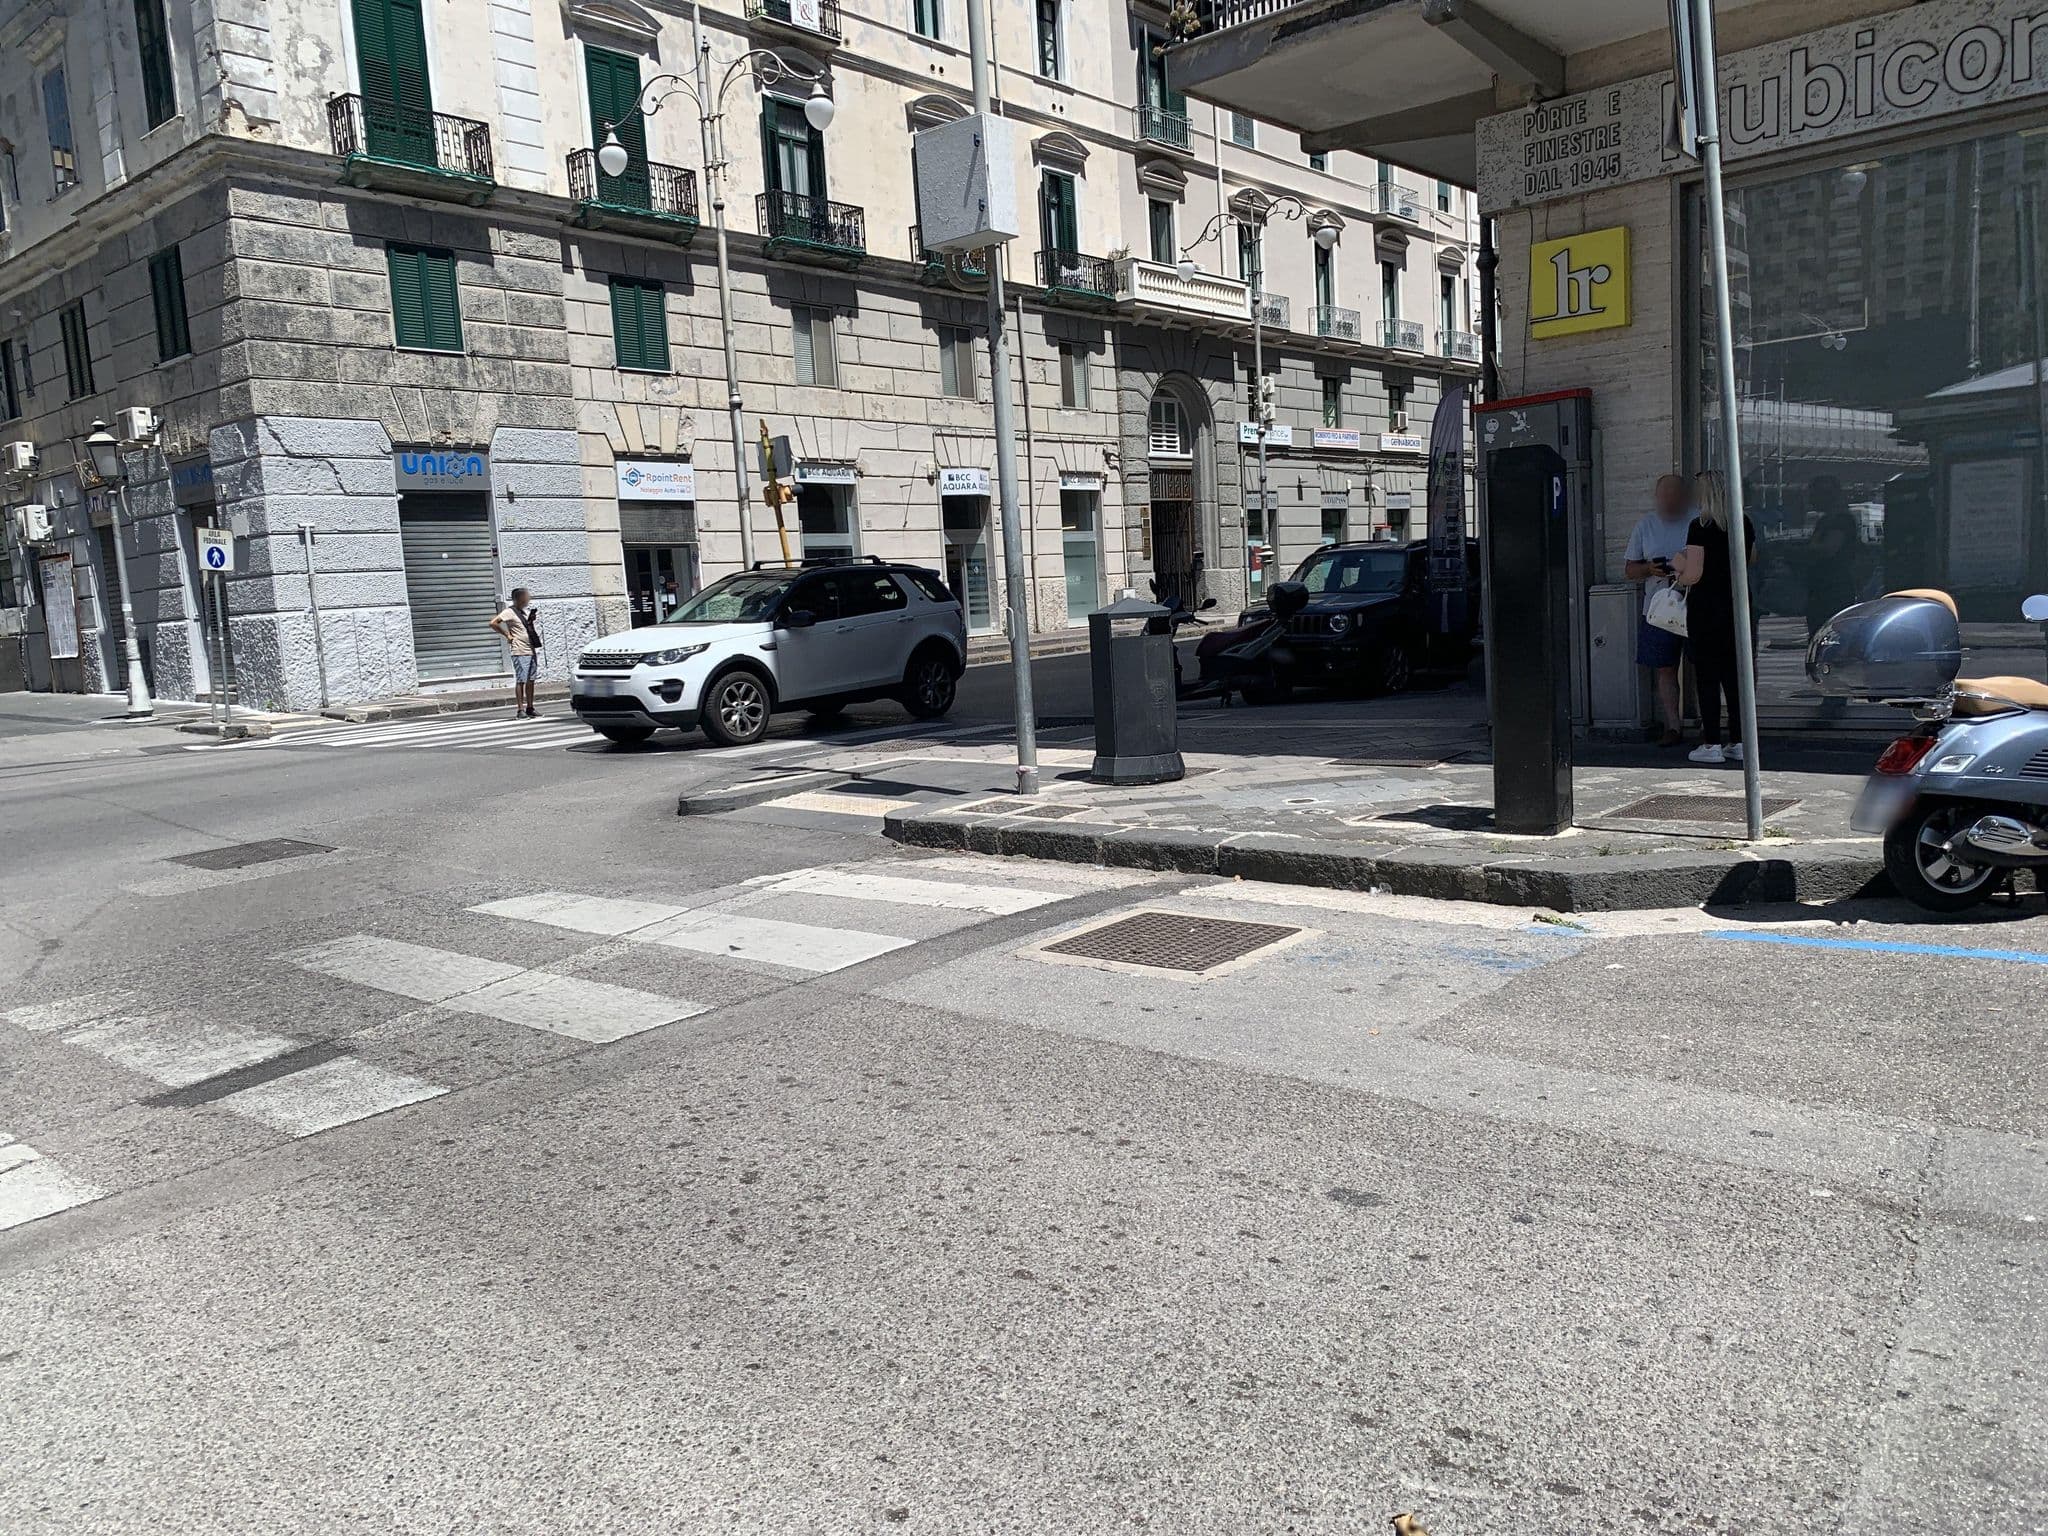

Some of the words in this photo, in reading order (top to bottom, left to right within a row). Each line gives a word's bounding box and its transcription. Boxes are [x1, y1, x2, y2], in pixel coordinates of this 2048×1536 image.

[1523, 99, 1587, 138] PORTE
[1608, 90, 1622, 117] E
[1524, 121, 1622, 168] FINESTRE
[1524, 166, 1562, 197] DAL
[1569, 152, 1621, 188] 1945
[645, 472, 692, 484] RpointRent
[942, 482, 978, 491] AQUARA
[955, 473, 972, 482] BCC
[1552, 476, 1562, 510] P
